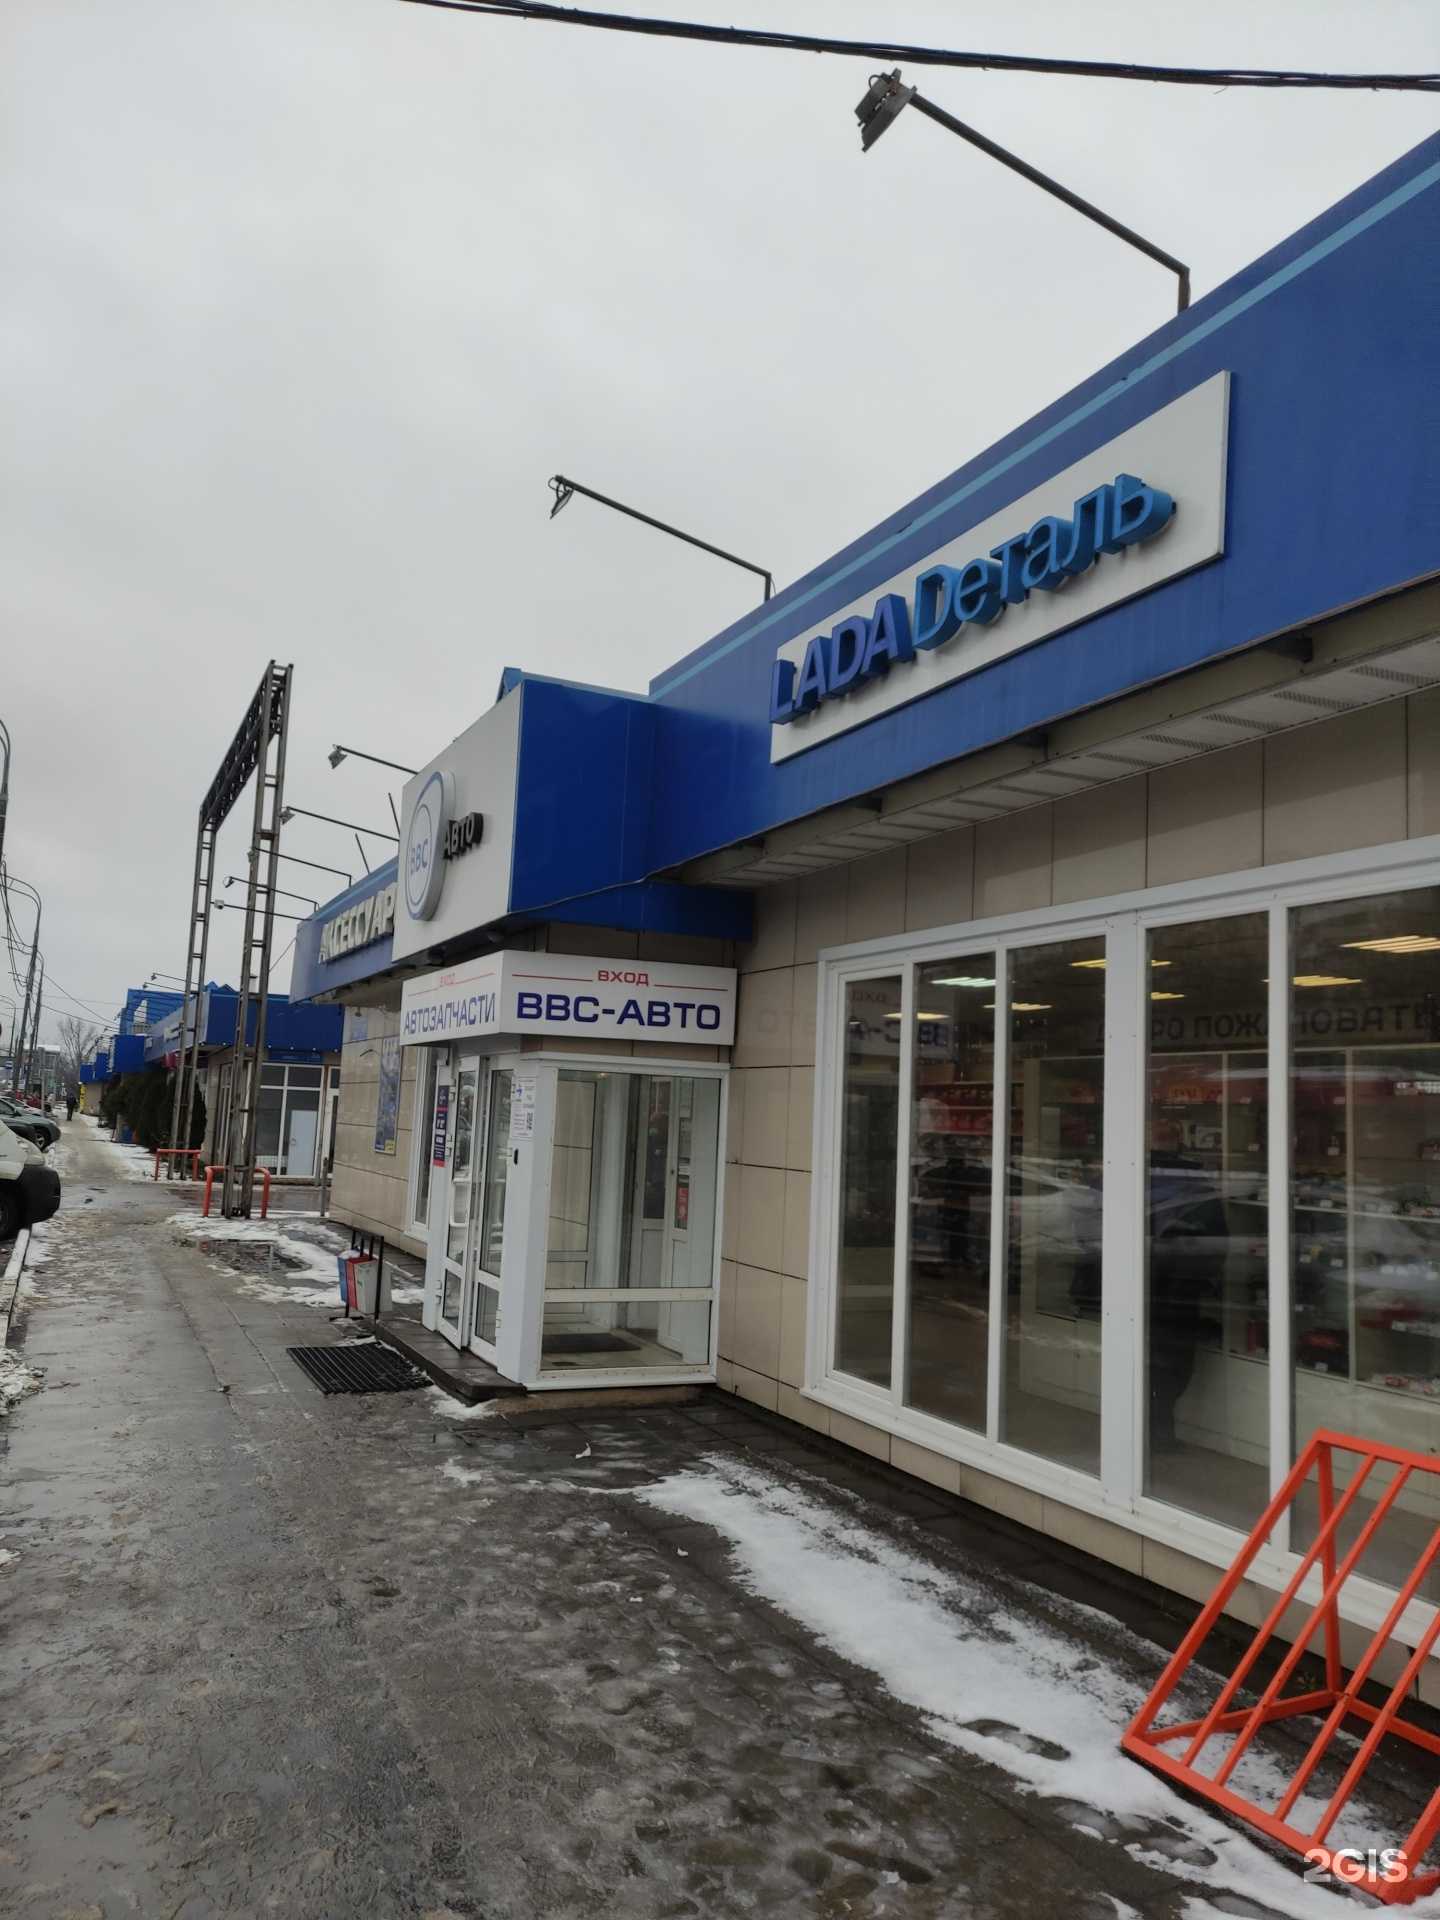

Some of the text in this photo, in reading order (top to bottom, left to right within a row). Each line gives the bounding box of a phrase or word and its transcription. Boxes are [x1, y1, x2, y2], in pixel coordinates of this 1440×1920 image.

[769, 593, 915, 725] LADA
[597, 969, 649, 986] ВХОД
[403, 992, 496, 1035] АВТОЗАПЧАСТИ
[516, 991, 721, 1030] ВВС-АВТО
